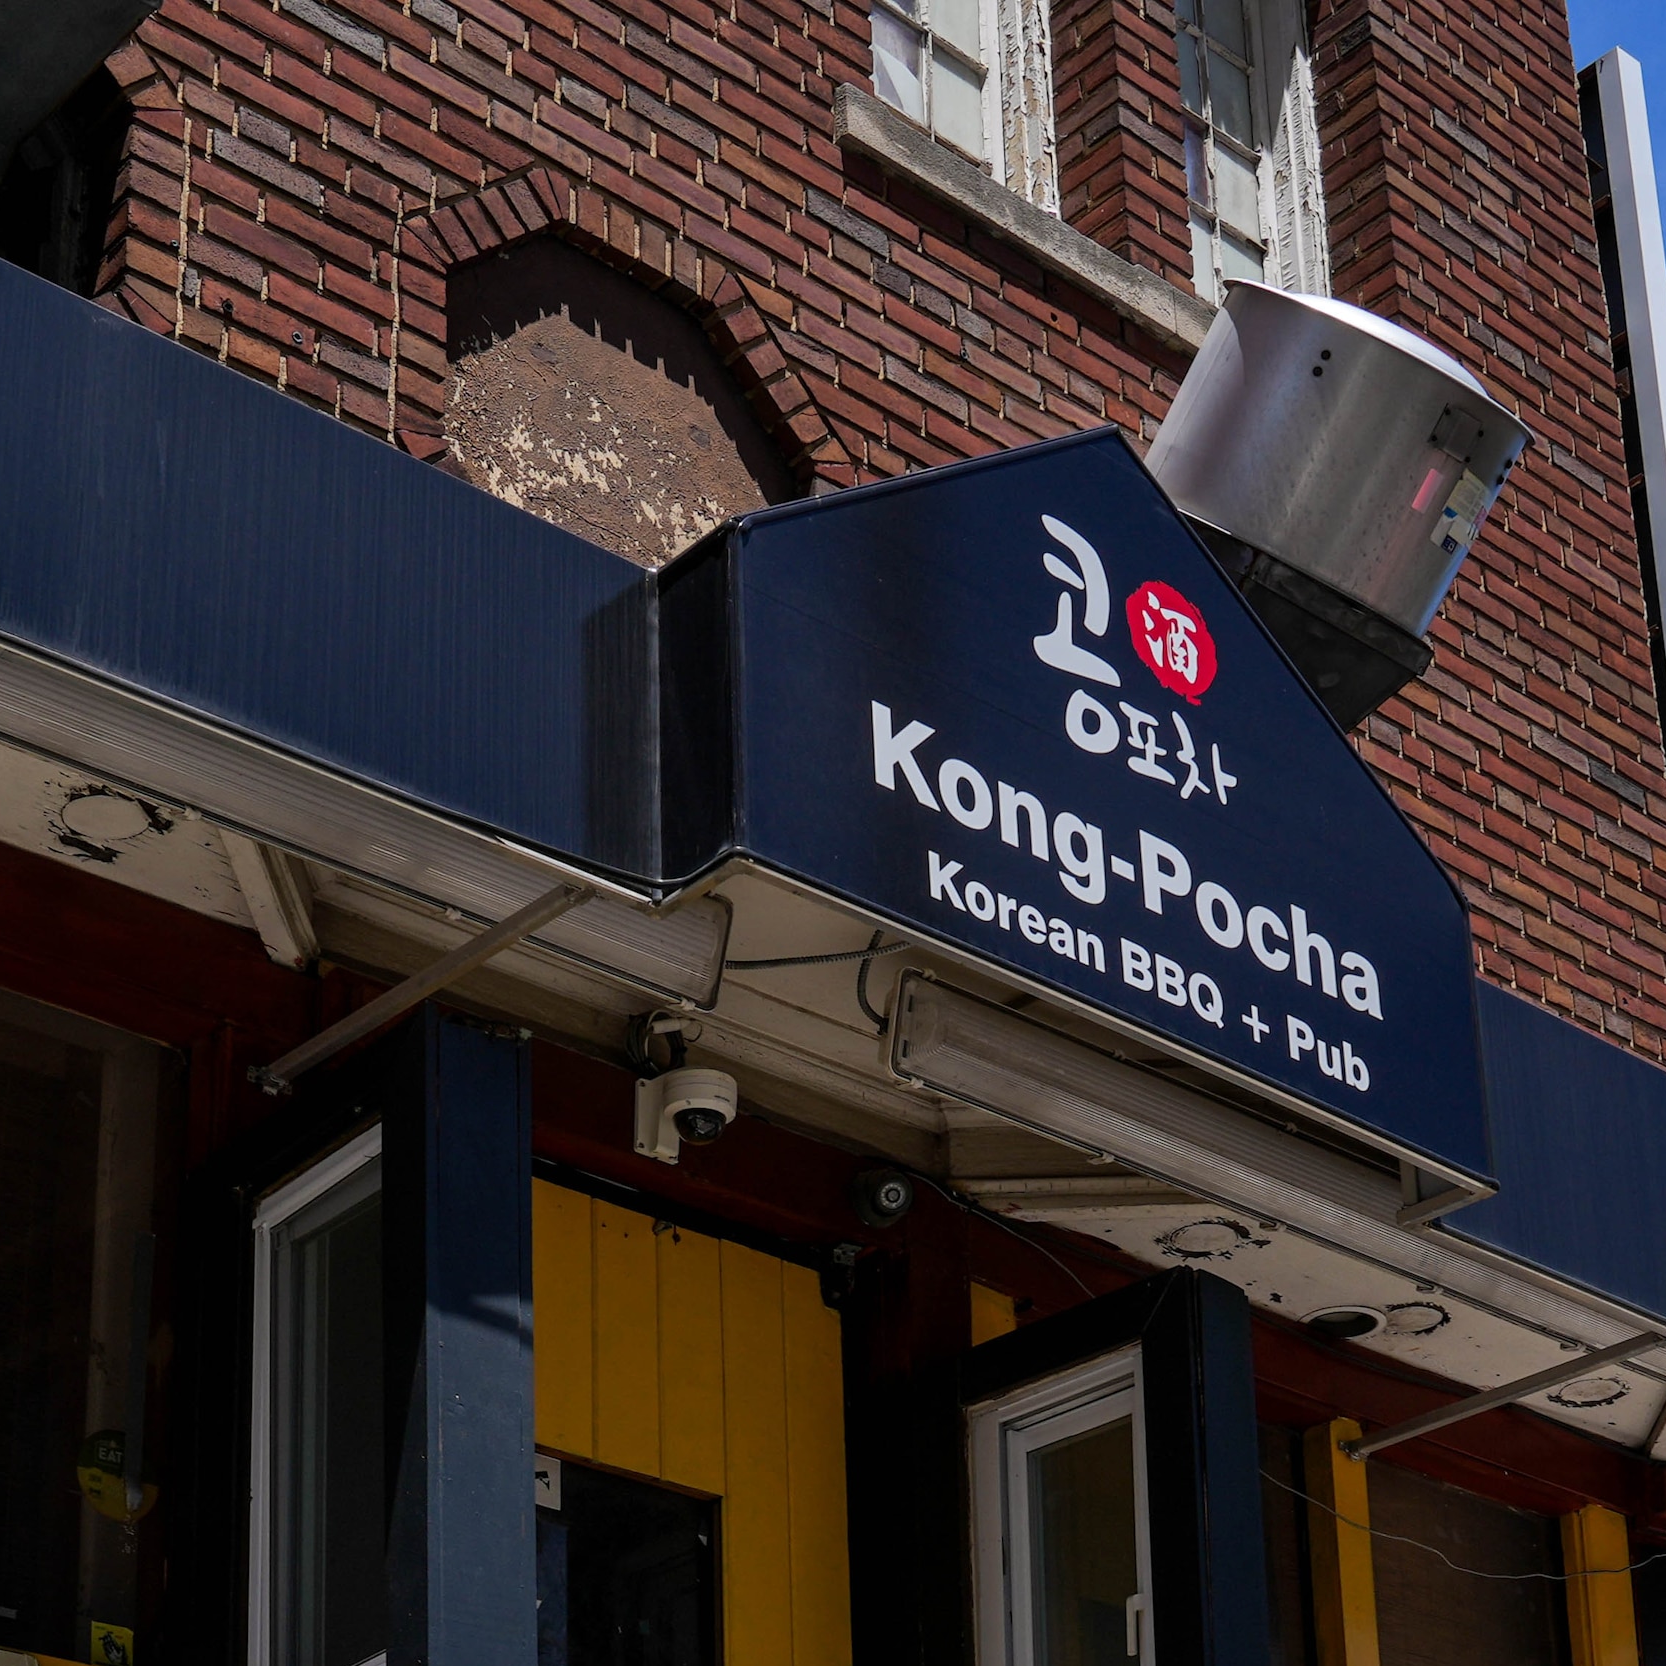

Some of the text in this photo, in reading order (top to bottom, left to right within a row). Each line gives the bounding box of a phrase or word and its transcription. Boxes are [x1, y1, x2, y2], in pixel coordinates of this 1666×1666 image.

[871, 700, 1385, 1021] Kong-Pocha
[927, 850, 1106, 974] Korean
[1121, 936, 1225, 1029] BBQ
[1286, 1014, 1371, 1092] Pub
